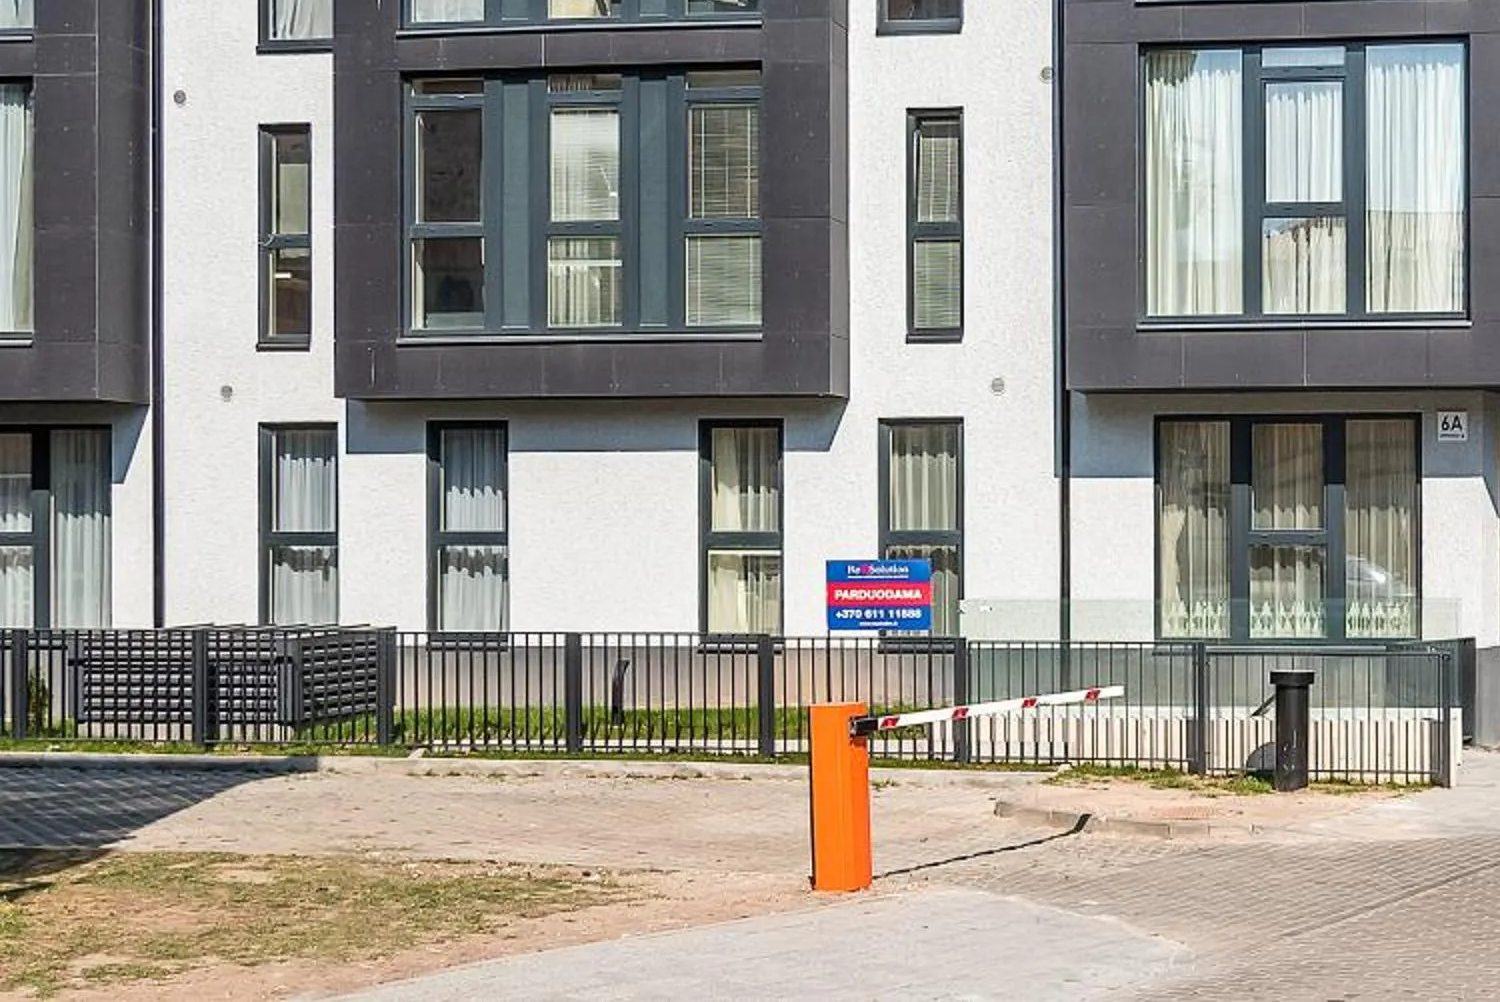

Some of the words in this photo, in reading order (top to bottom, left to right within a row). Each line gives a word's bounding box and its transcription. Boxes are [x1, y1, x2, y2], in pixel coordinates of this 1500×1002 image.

[1441, 415, 1463, 431] 6A
[834, 589, 922, 601] PARDUODAMA
[835, 608, 862, 619] +370
